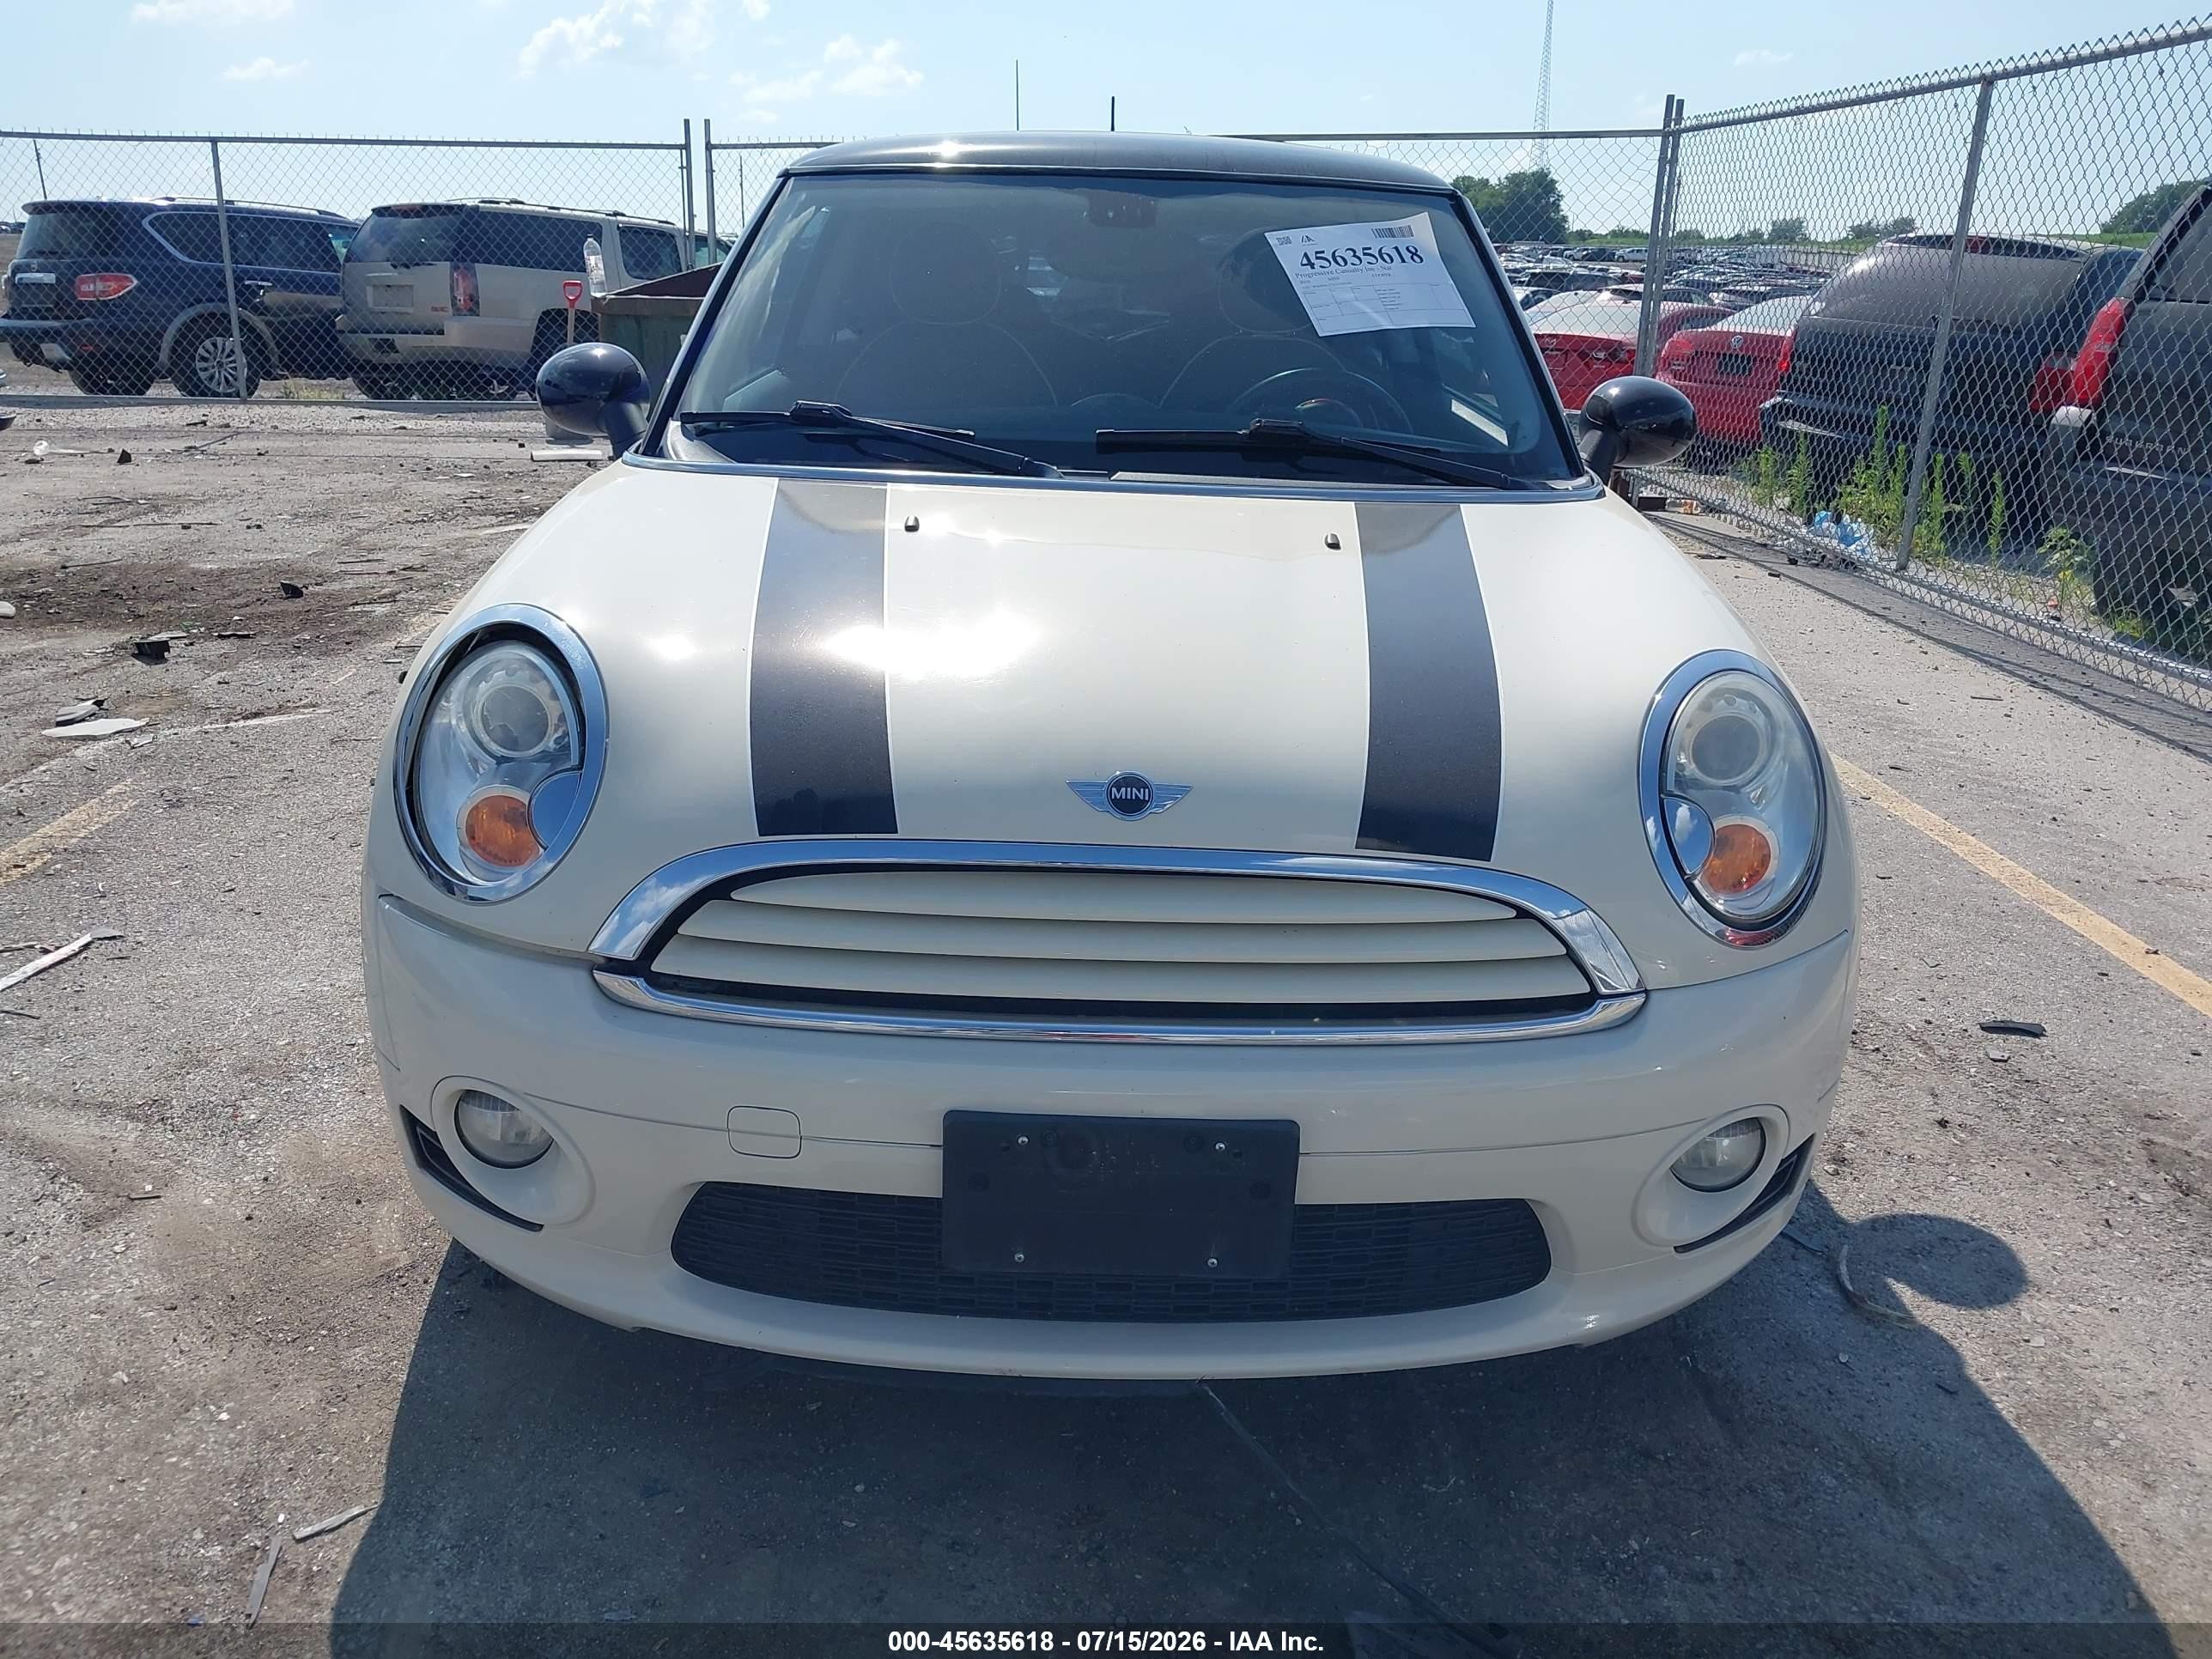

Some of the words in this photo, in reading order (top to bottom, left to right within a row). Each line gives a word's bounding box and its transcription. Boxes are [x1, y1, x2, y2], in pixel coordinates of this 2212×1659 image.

[1299, 245, 1424, 270] 45635618
[1295, 270, 1334, 279] Progressive
[1334, 266, 1364, 276] Casualty
[1111, 787, 1149, 801] MINI
